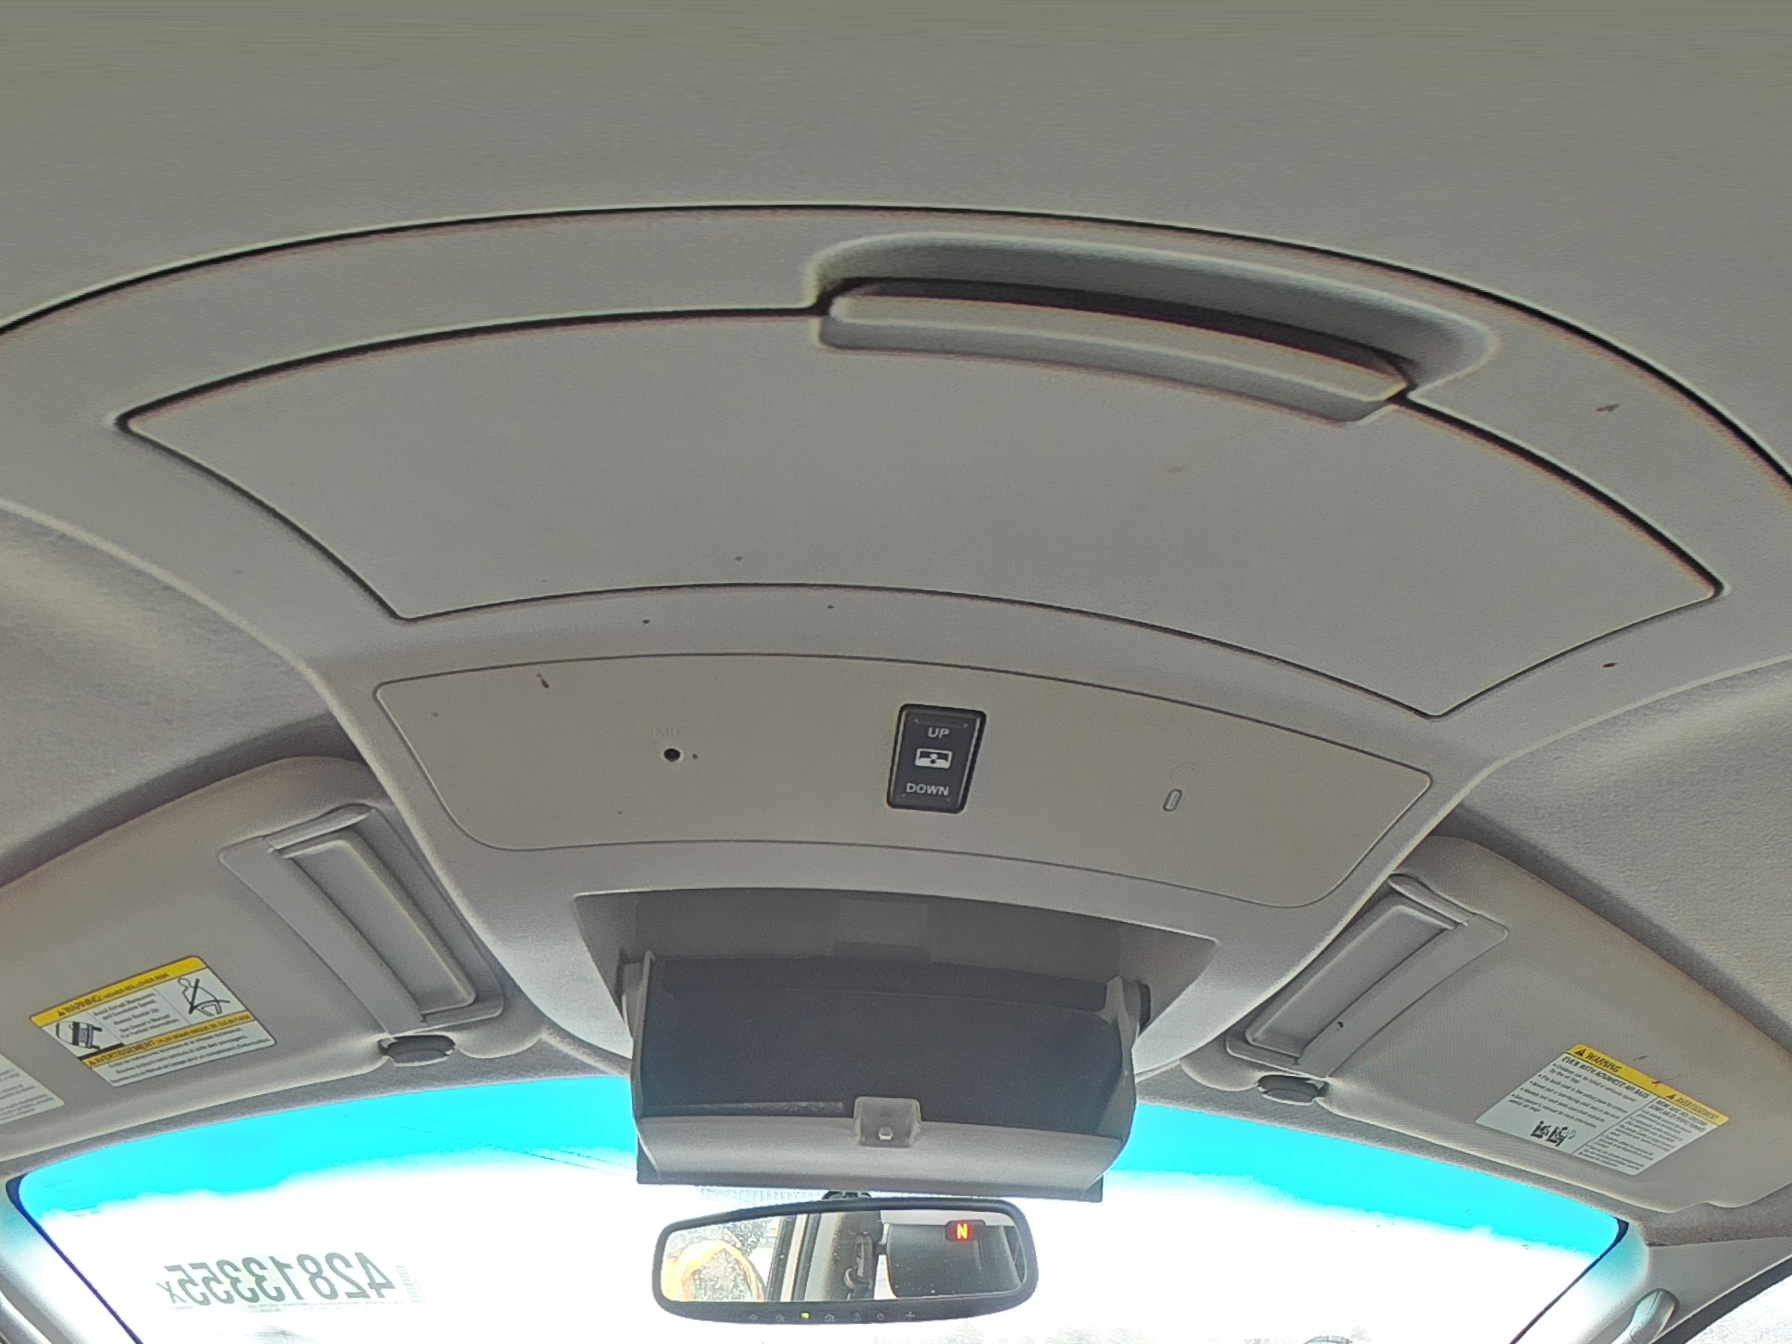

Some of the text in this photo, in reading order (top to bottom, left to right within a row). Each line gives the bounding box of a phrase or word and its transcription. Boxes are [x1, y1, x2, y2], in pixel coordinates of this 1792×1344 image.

[928, 727, 950, 738] UP
[906, 783, 949, 796] DOWN
[957, 1223, 968, 1239] N
